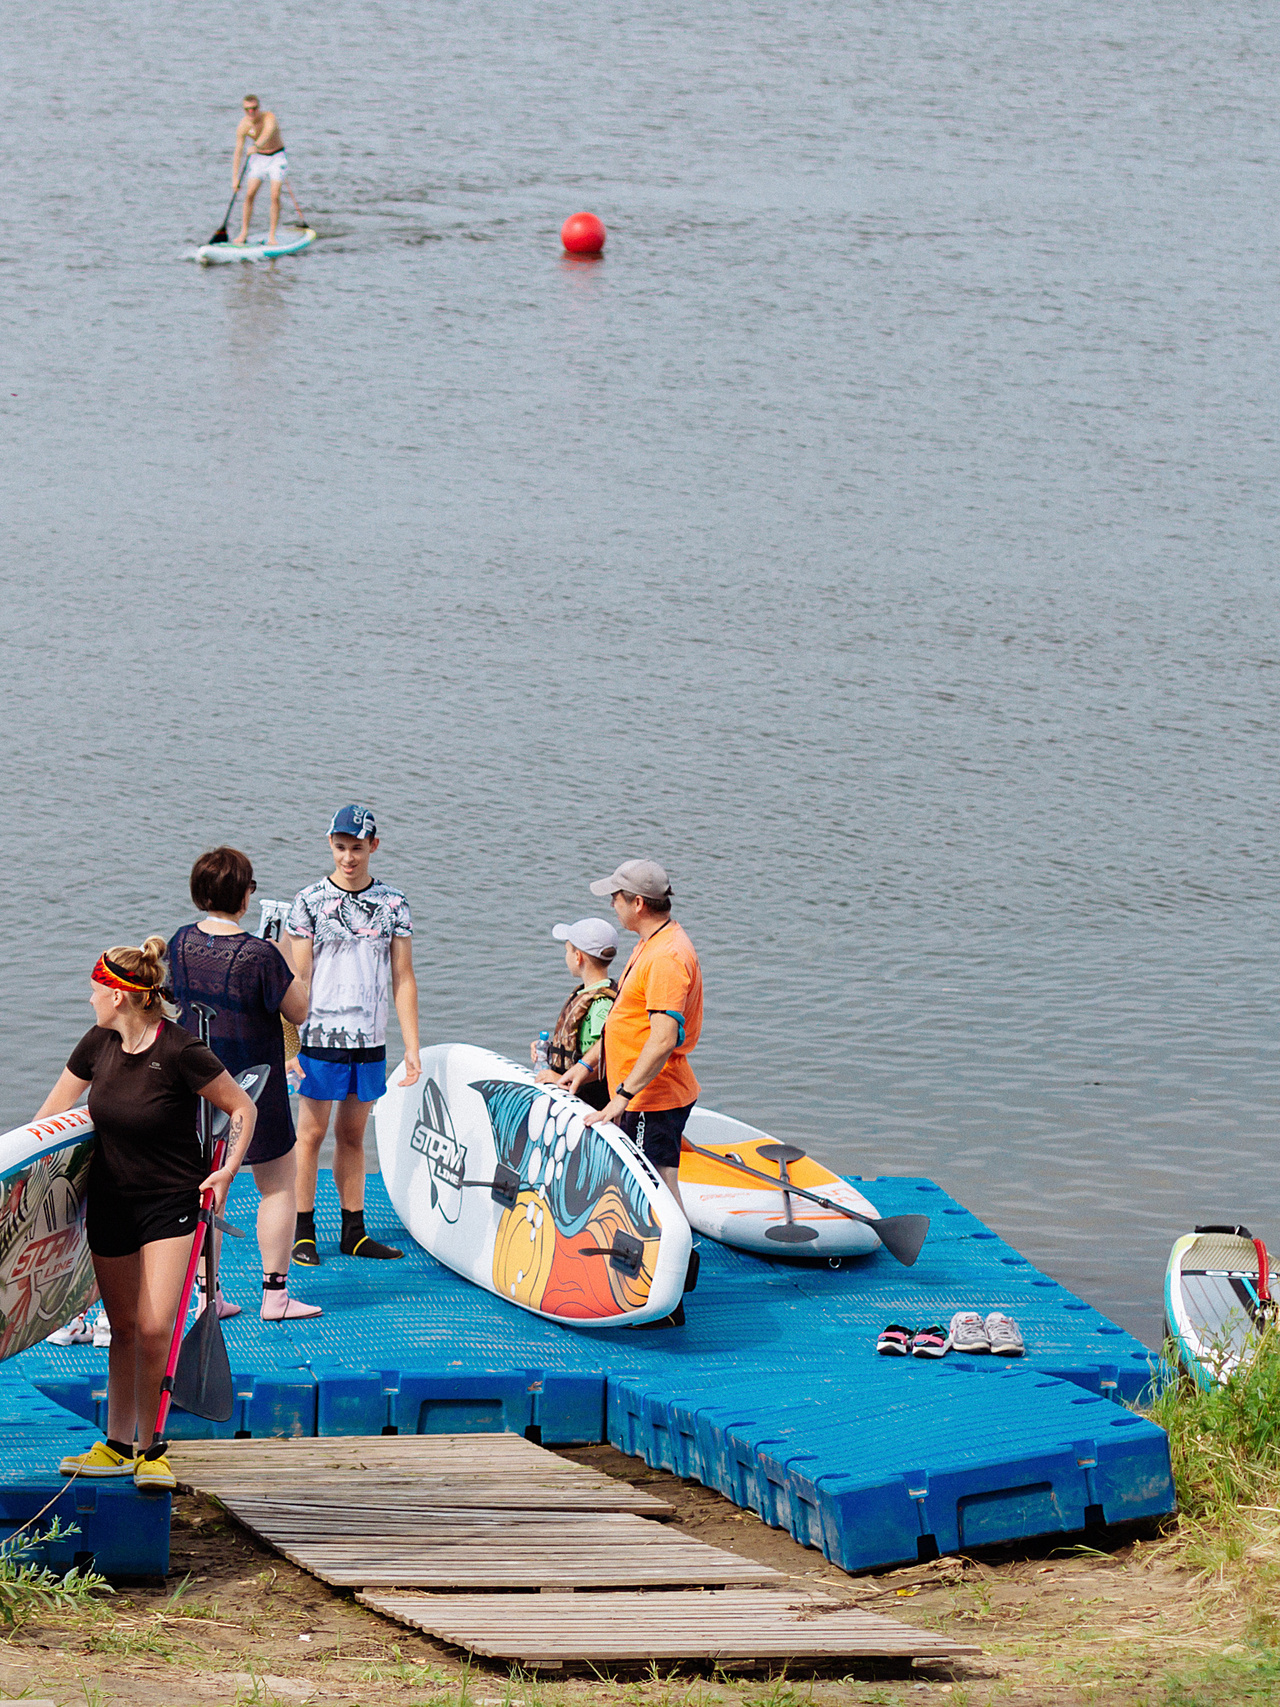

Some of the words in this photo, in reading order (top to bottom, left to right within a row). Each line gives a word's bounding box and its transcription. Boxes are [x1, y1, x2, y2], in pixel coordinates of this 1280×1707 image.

[411, 1124, 466, 1172] STORM
[635, 1121, 645, 1153] peedo
[436, 1165, 460, 1186] LINE
[44, 1256, 74, 1279] LINE
